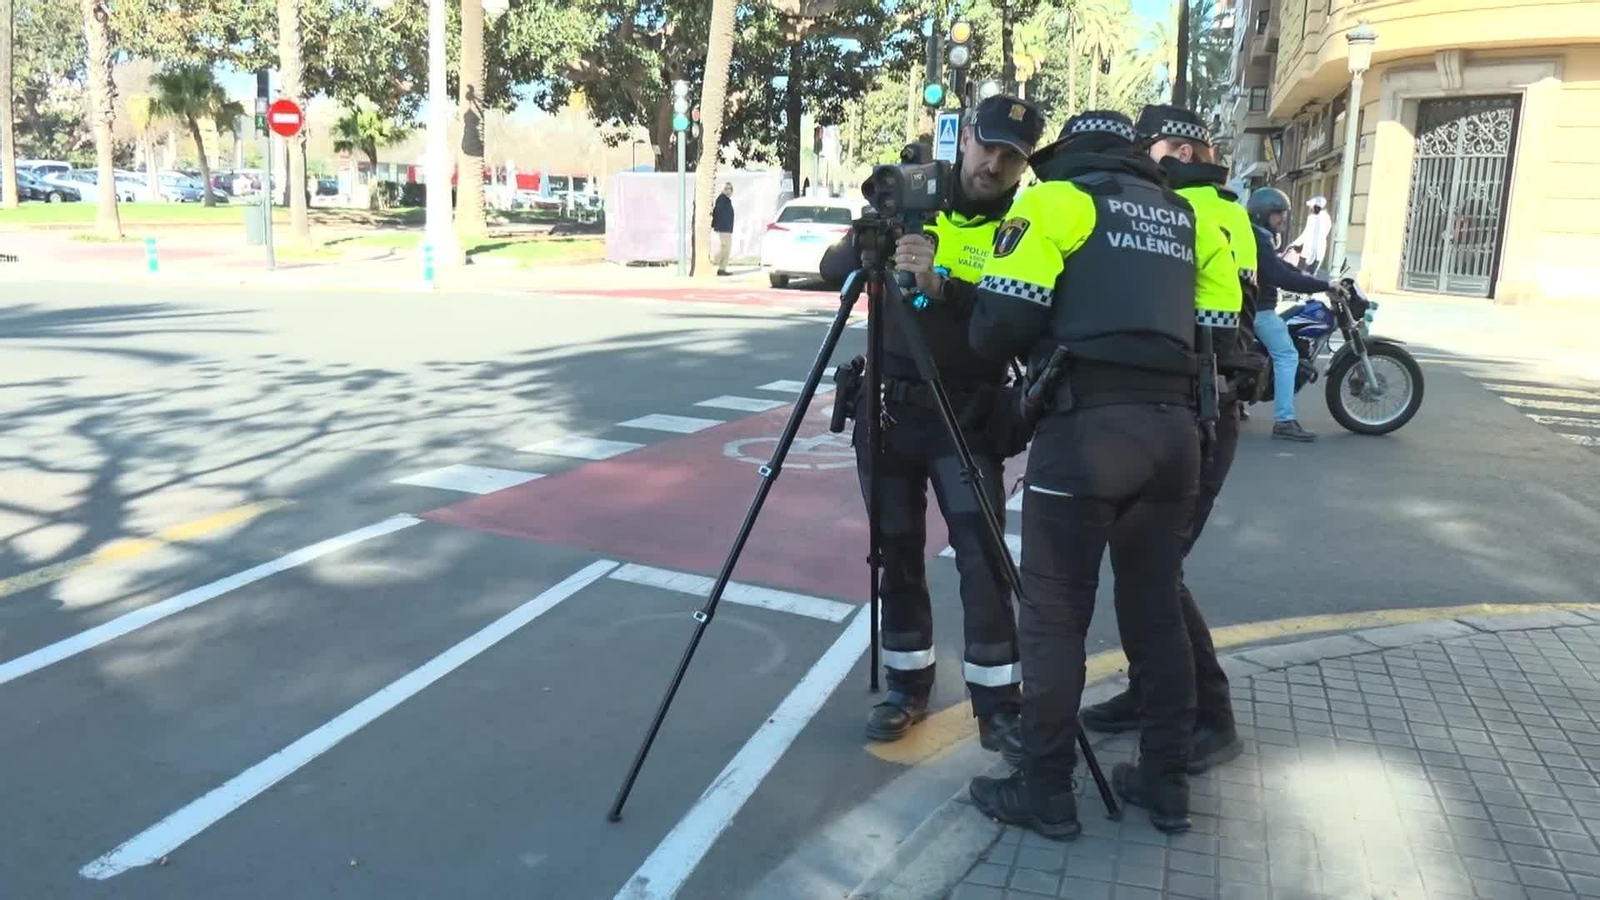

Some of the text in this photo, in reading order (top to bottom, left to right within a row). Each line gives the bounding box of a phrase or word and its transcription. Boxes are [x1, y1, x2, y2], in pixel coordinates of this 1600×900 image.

[1107, 199, 1192, 228] POLICIA
[1131, 219, 1176, 239] LOCAL
[1106, 231, 1194, 265] VALÈNCIA
